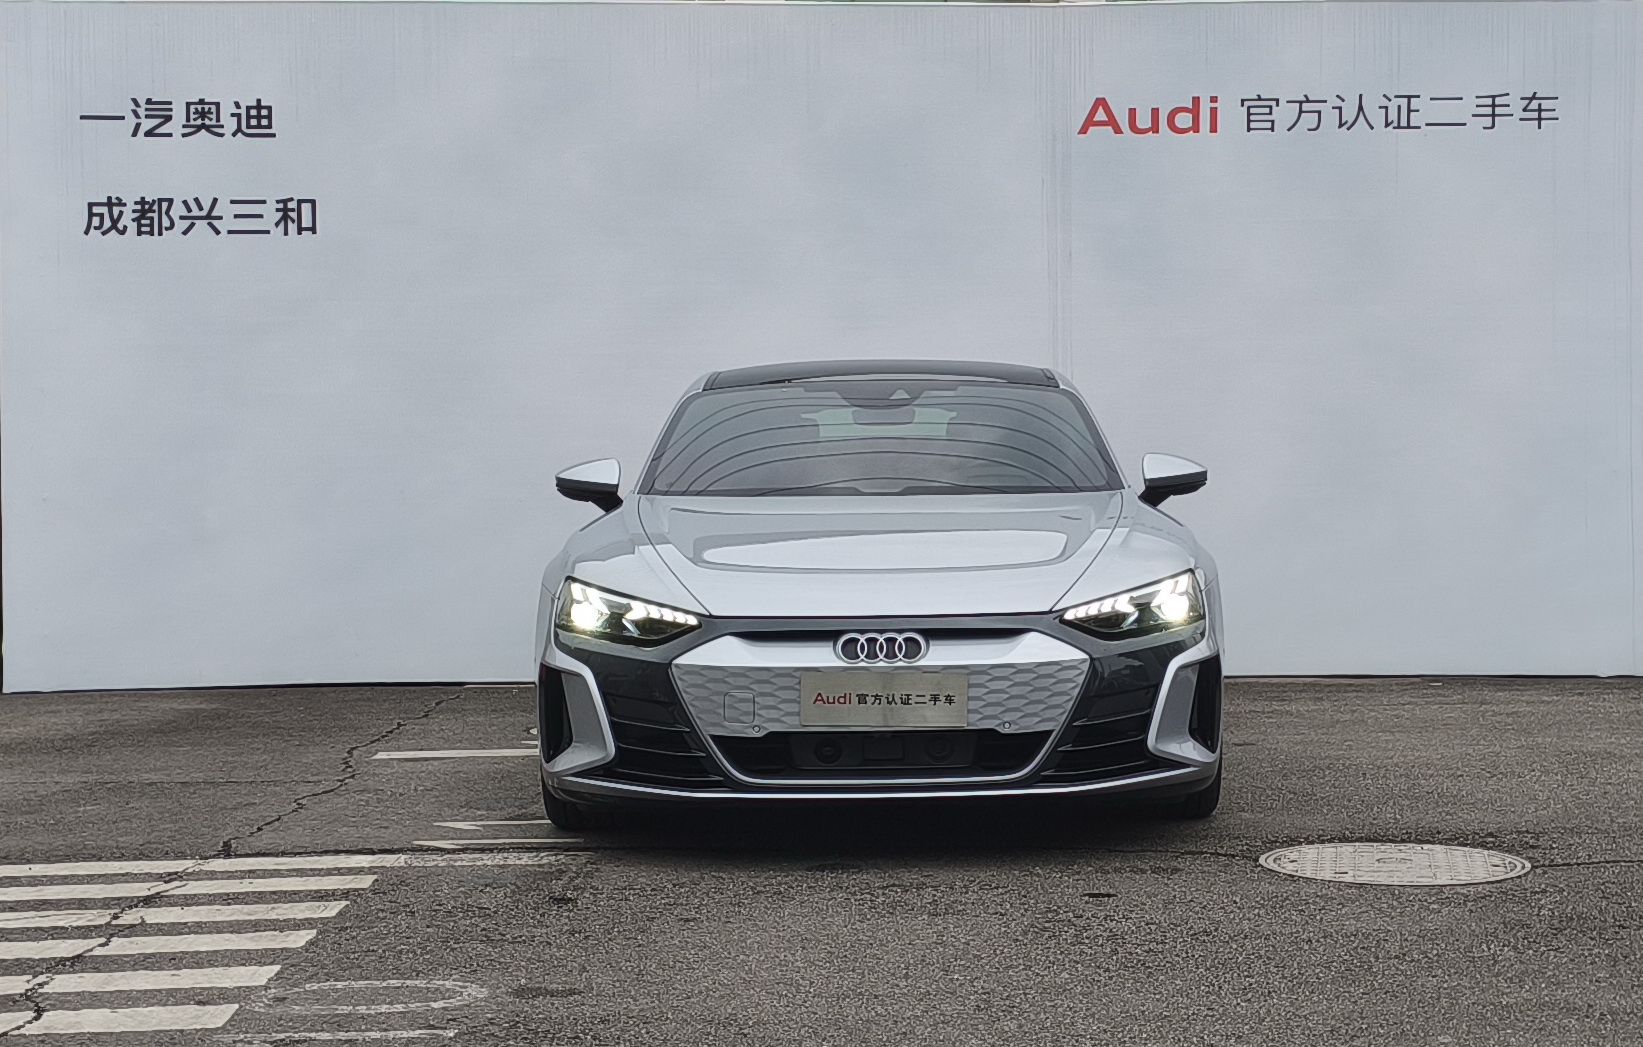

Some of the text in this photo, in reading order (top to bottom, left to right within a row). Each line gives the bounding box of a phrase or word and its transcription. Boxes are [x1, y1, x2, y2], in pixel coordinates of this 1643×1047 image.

[79, 97, 277, 139] 一汽奥迪
[1078, 91, 1560, 135] Audi 官方认证二手车
[83, 195, 318, 237] 成都兴三和
[812, 692, 957, 707] Audi 官方认证二手车
